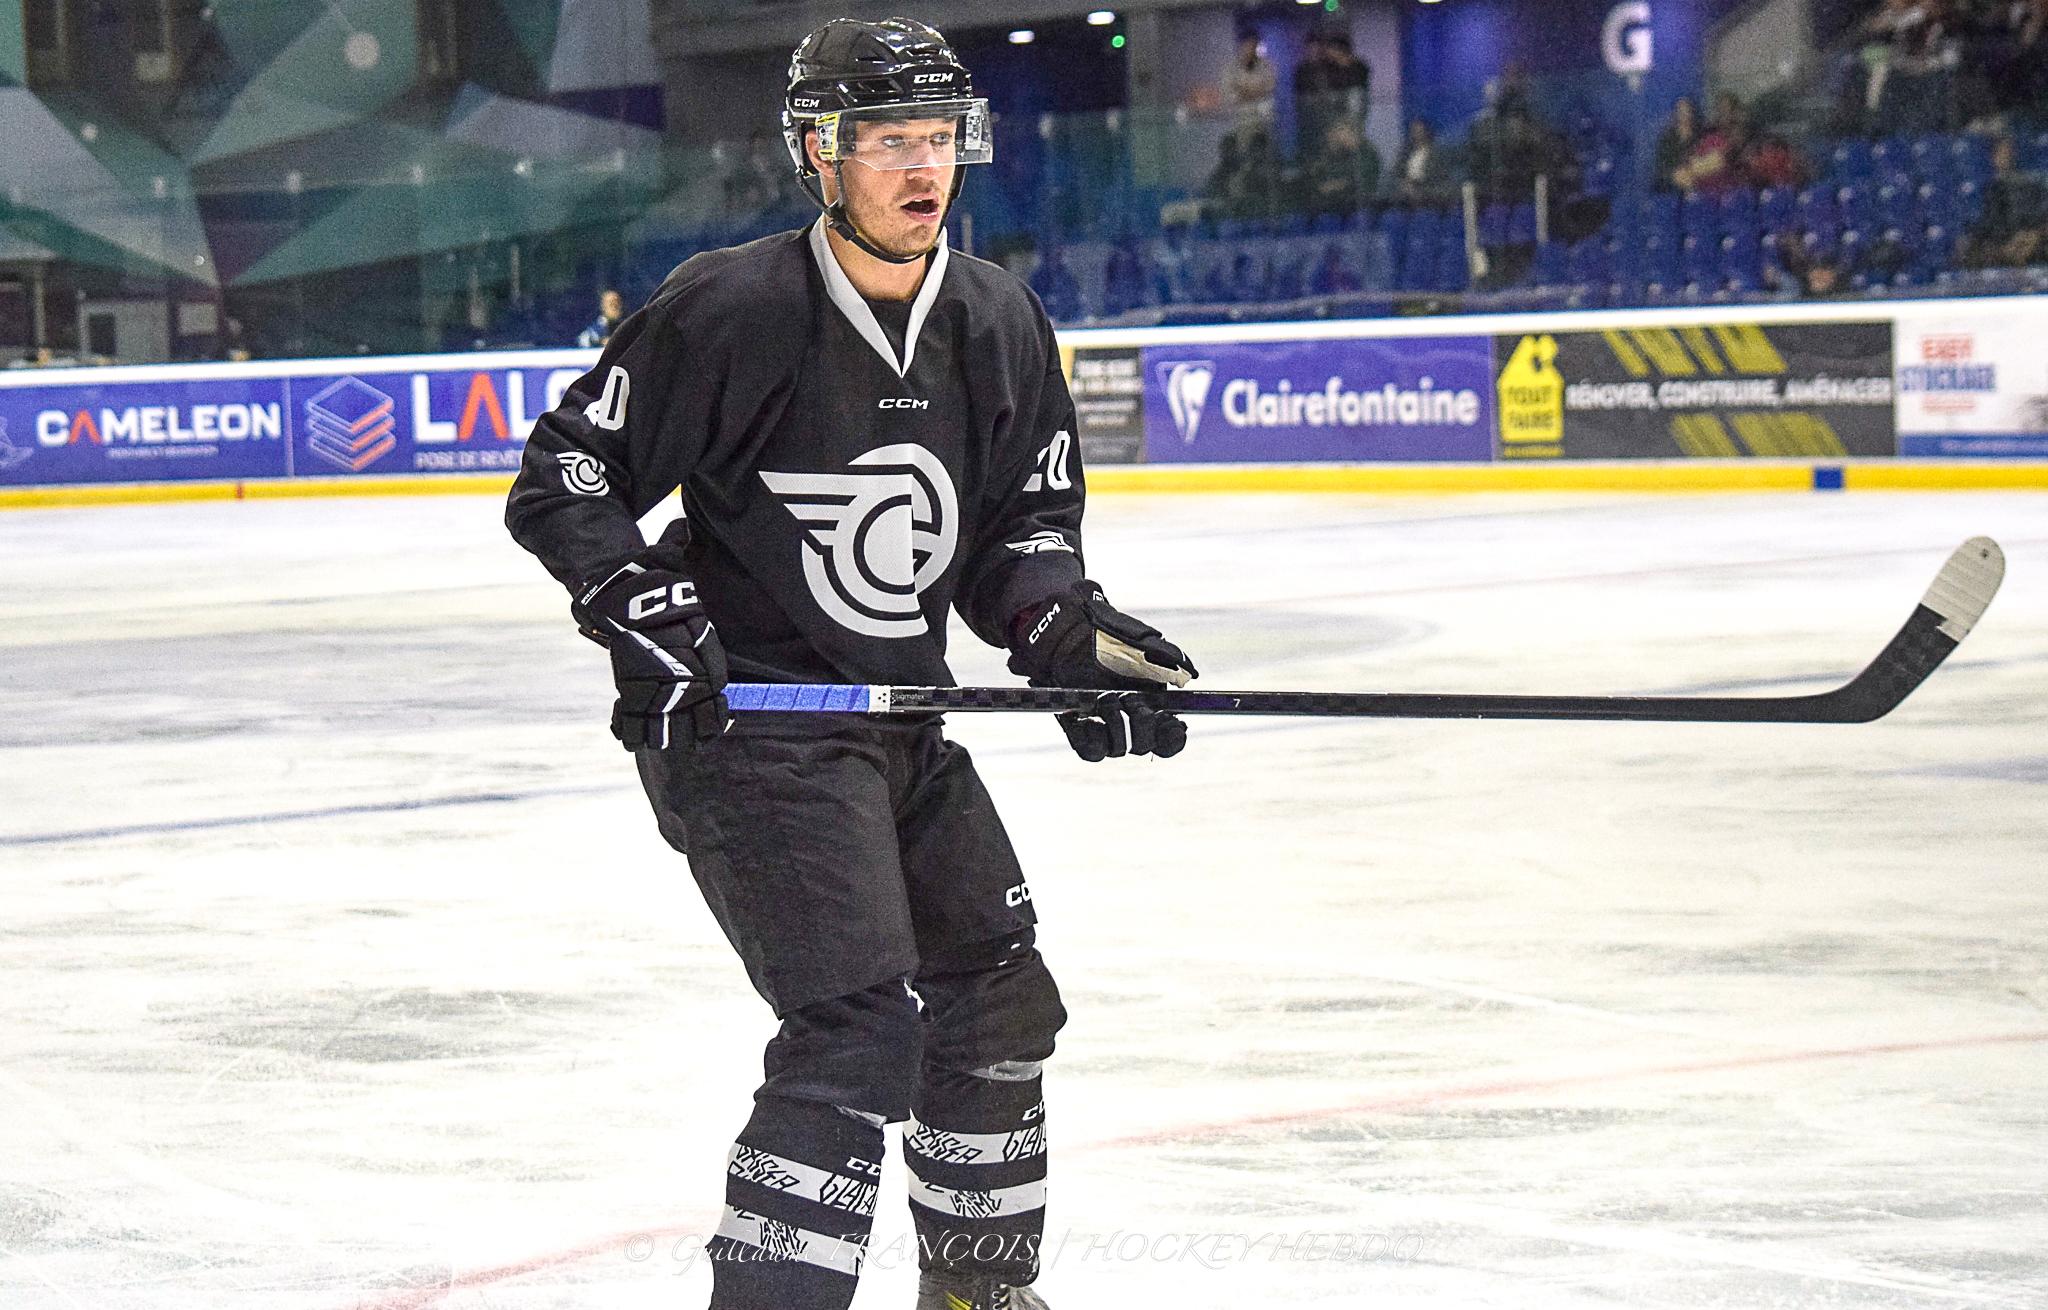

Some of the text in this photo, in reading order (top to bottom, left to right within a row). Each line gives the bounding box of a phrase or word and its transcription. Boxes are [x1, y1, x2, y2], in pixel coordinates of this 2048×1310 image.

[1602, 3, 1653, 71] G
[913, 72, 954, 85] CCM
[794, 97, 820, 109] CCM
[878, 398, 930, 410] CCM
[1221, 375, 1479, 427] Clairefontaine
[37, 402, 282, 446] CAMELEON
[1028, 602, 1061, 645] CCM
